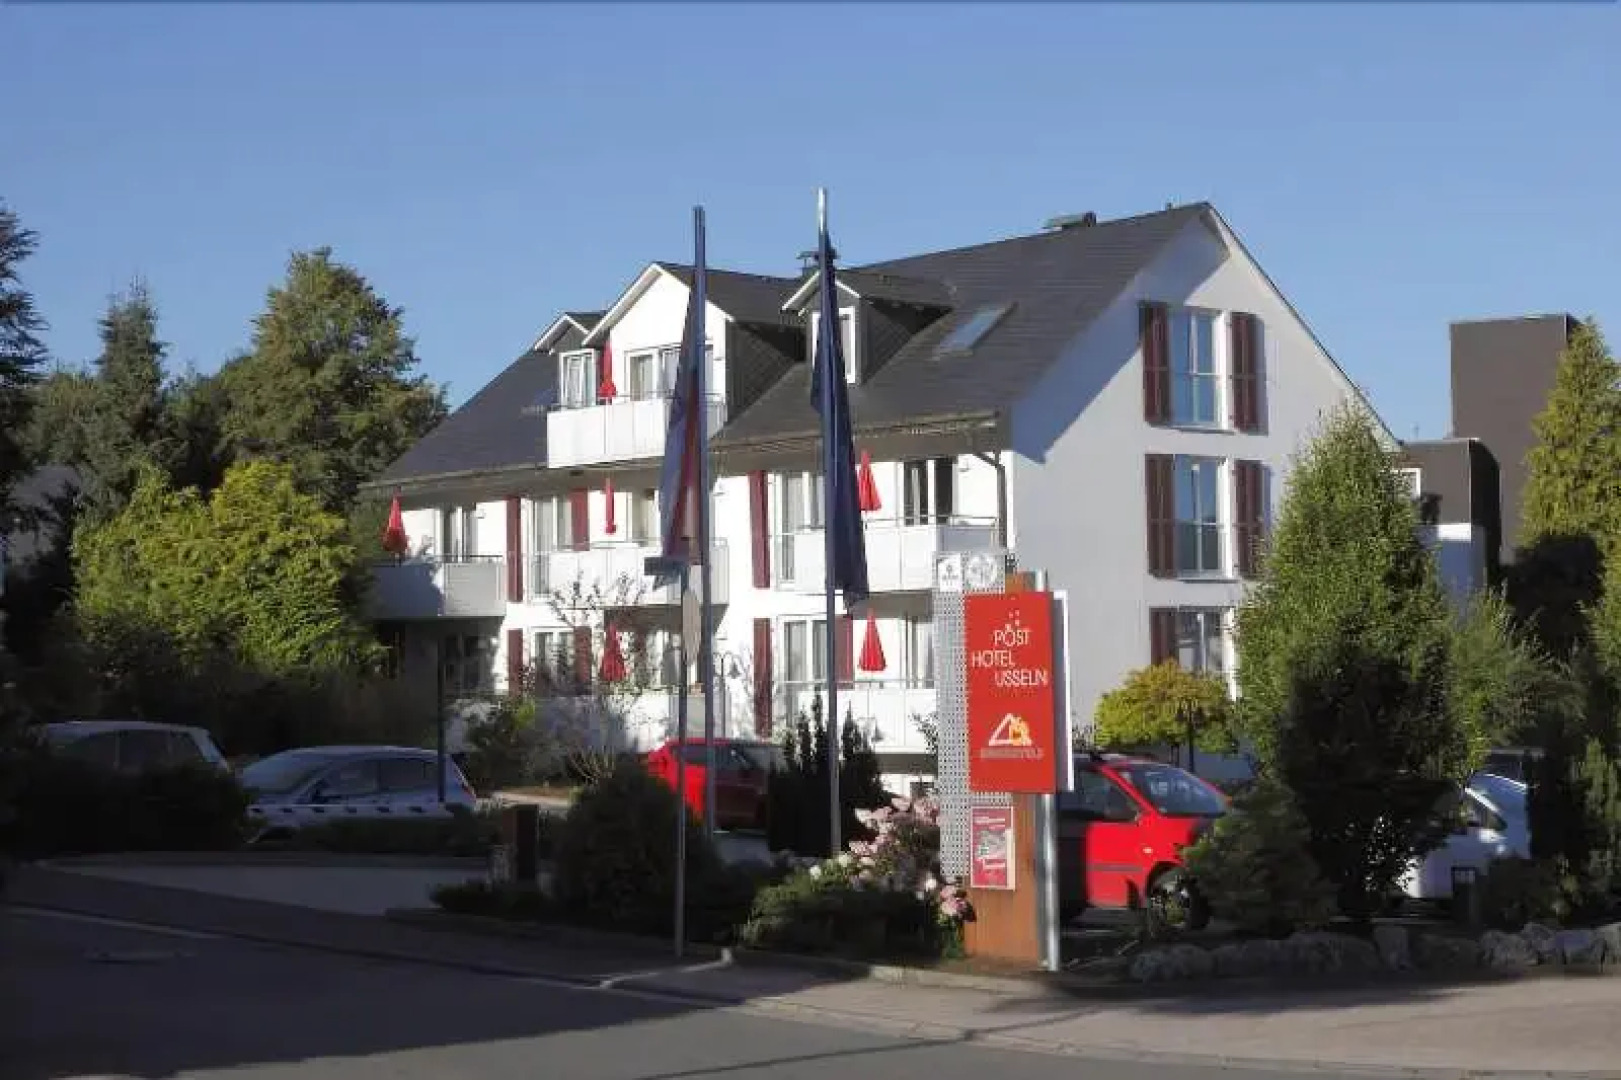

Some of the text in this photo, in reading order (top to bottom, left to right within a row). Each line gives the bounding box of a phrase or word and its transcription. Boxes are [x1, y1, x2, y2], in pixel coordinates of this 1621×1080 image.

[994, 628, 1032, 646] POST
[972, 650, 1015, 667] HOTEL
[995, 668, 1048, 686] USSELN
